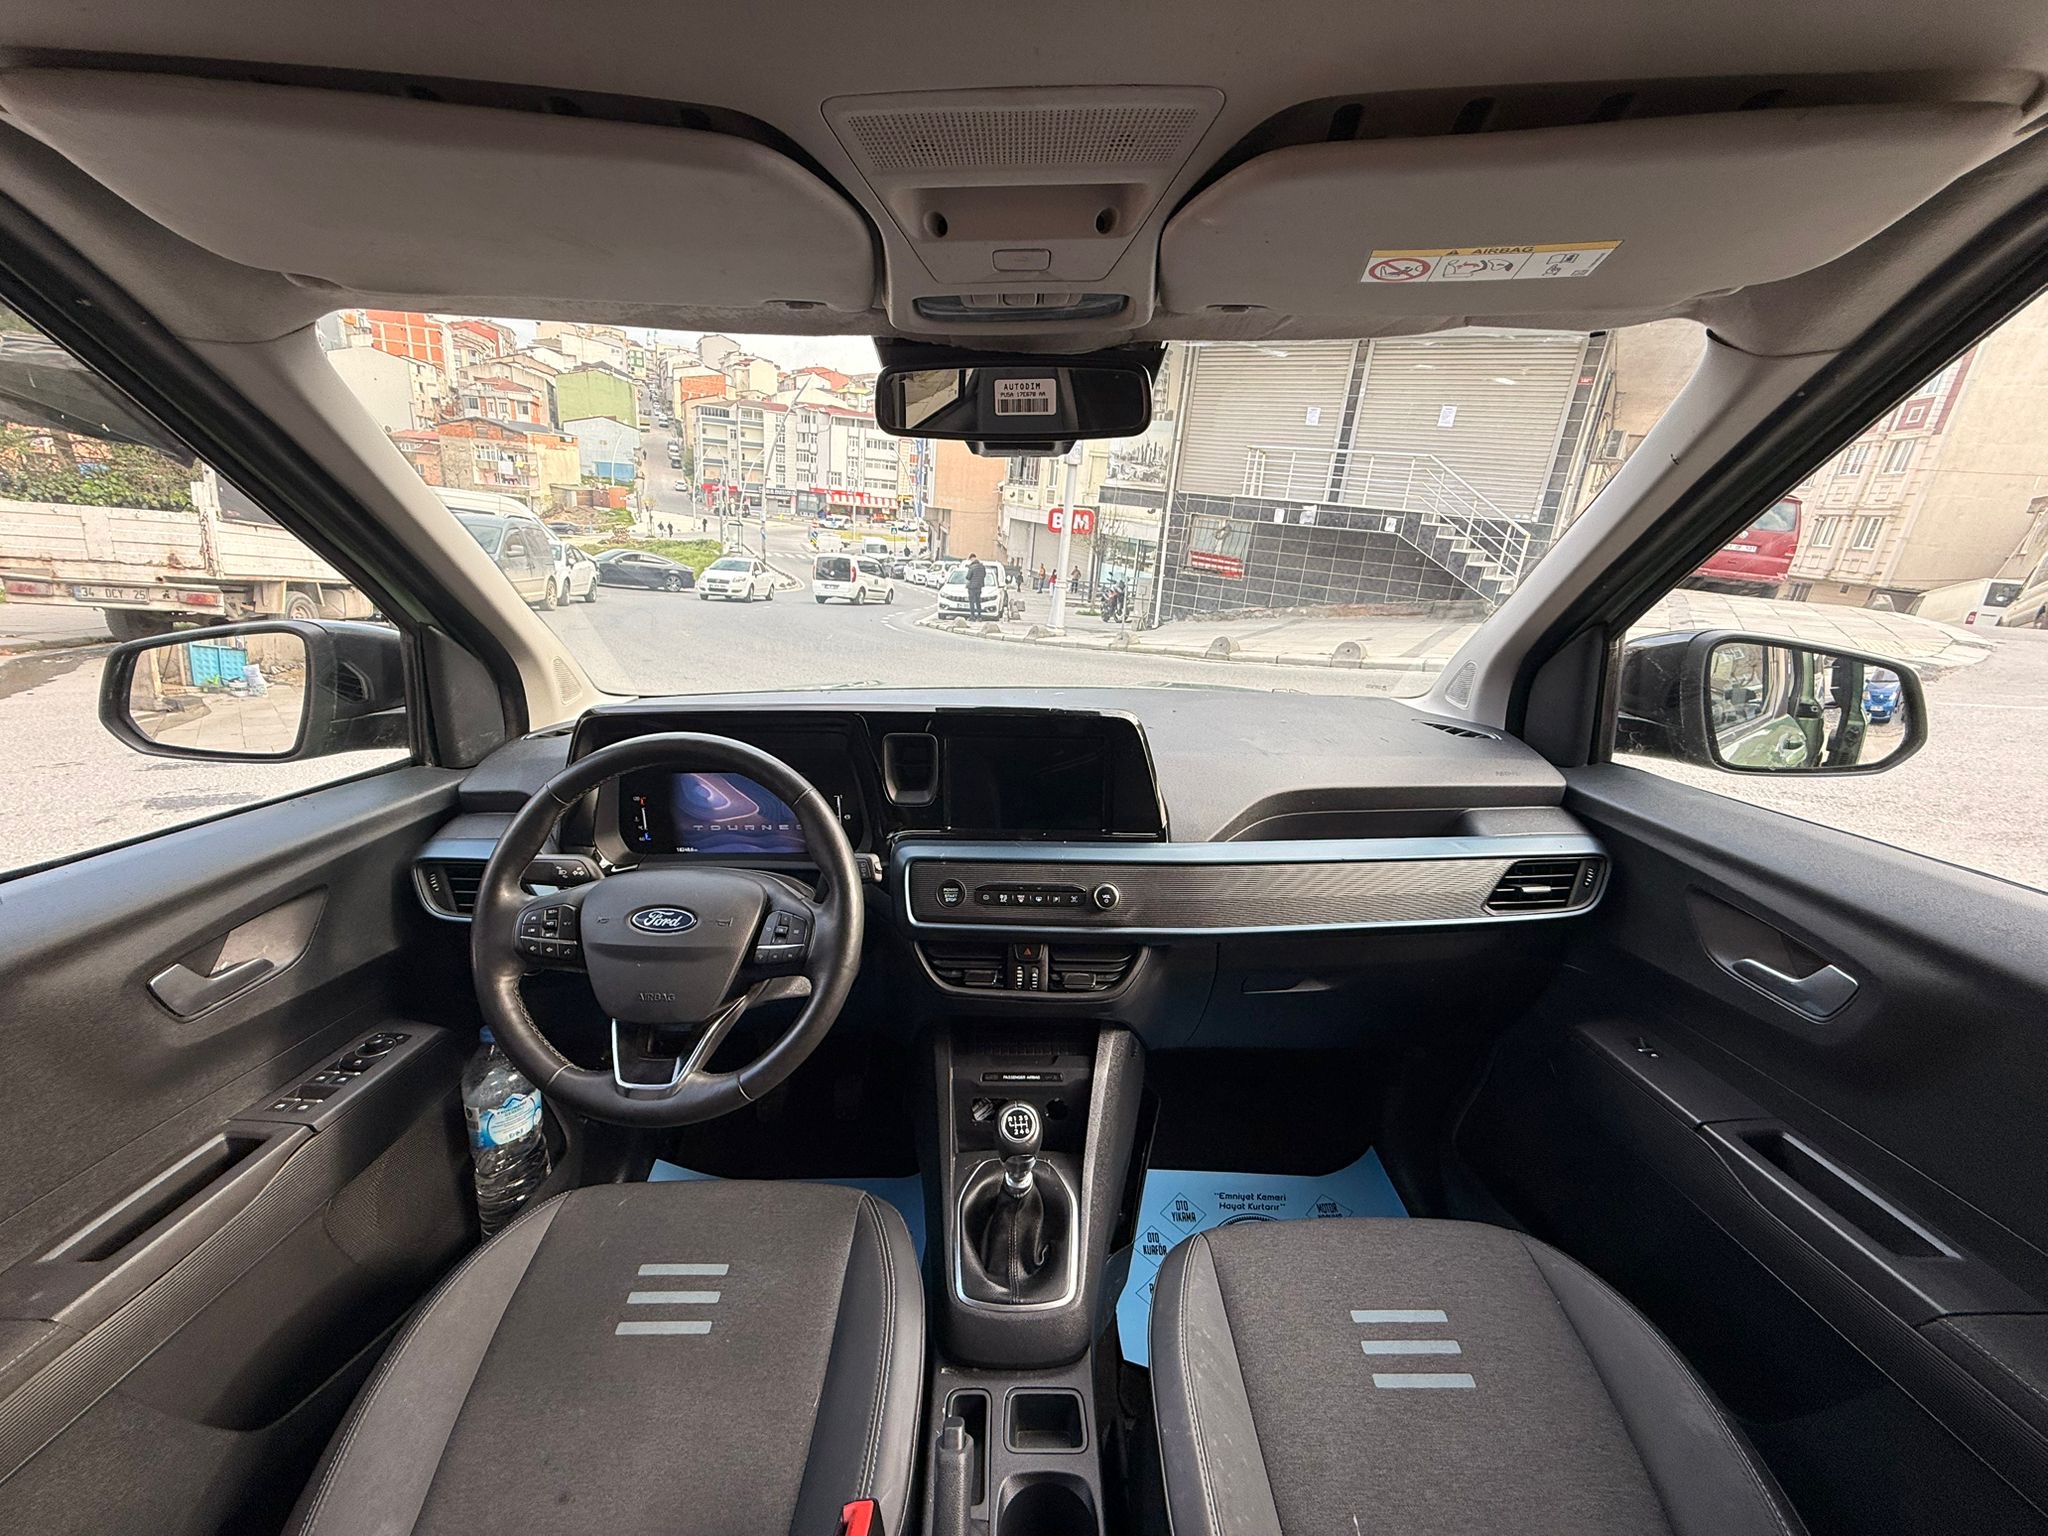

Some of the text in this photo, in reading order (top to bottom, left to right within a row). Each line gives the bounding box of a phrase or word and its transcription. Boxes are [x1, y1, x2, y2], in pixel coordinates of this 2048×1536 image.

[1003, 383, 1041, 391] AUTODIM
[1052, 512, 1090, 530] BM
[82, 587, 95, 597] 34
[133, 590, 146, 600] 25
[643, 910, 683, 927] Ford
[1175, 1200, 1189, 1211] OTO
[1219, 1202, 1246, 1211] Hayat
[1146, 1232, 1160, 1243] OTO
